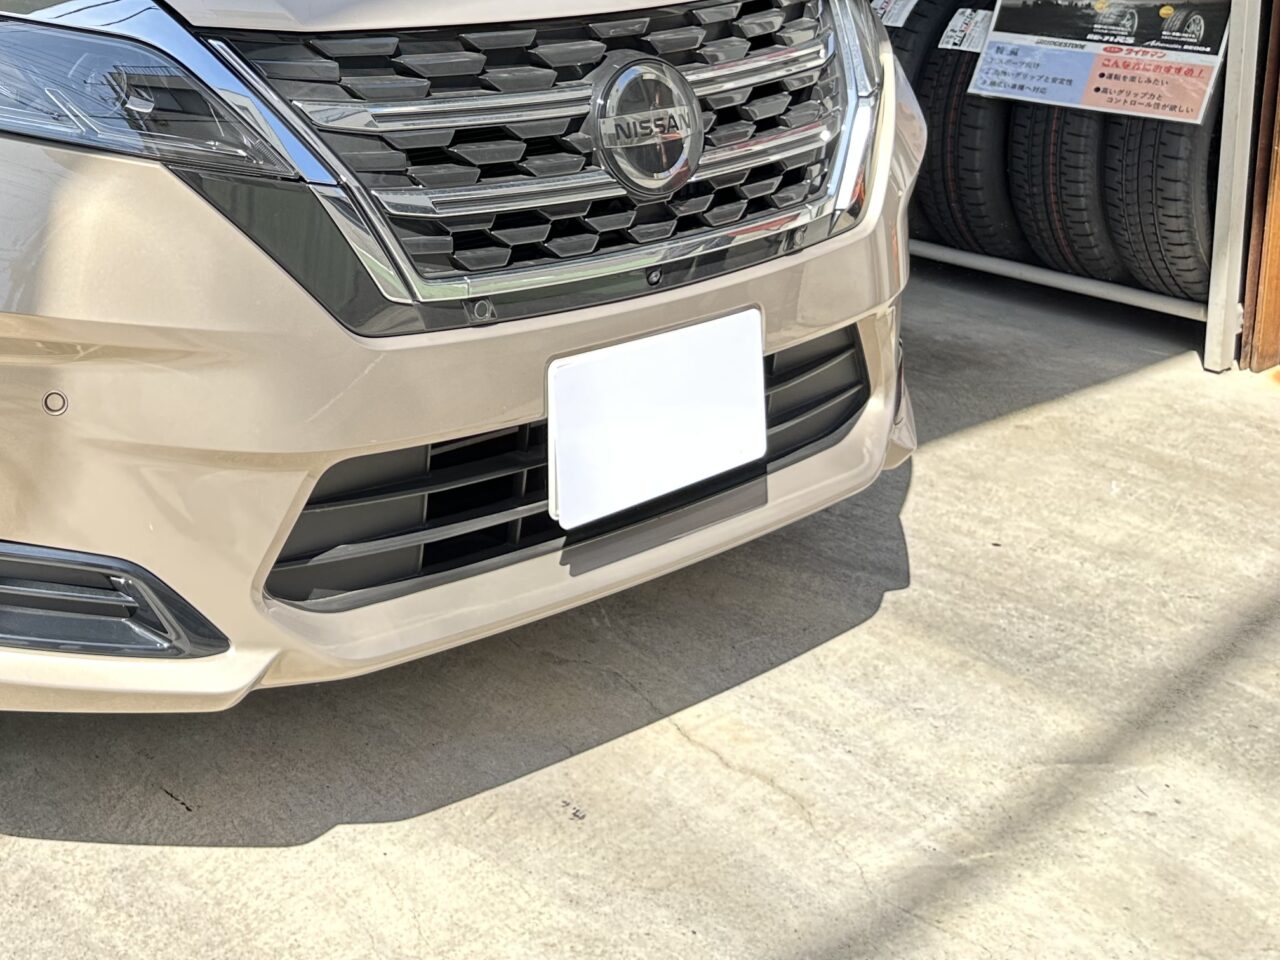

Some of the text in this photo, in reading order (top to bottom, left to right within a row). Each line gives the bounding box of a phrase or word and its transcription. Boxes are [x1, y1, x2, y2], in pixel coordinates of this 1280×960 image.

[1124, 48, 1168, 58] タイヤマン
[614, 111, 689, 140] NISSAN
